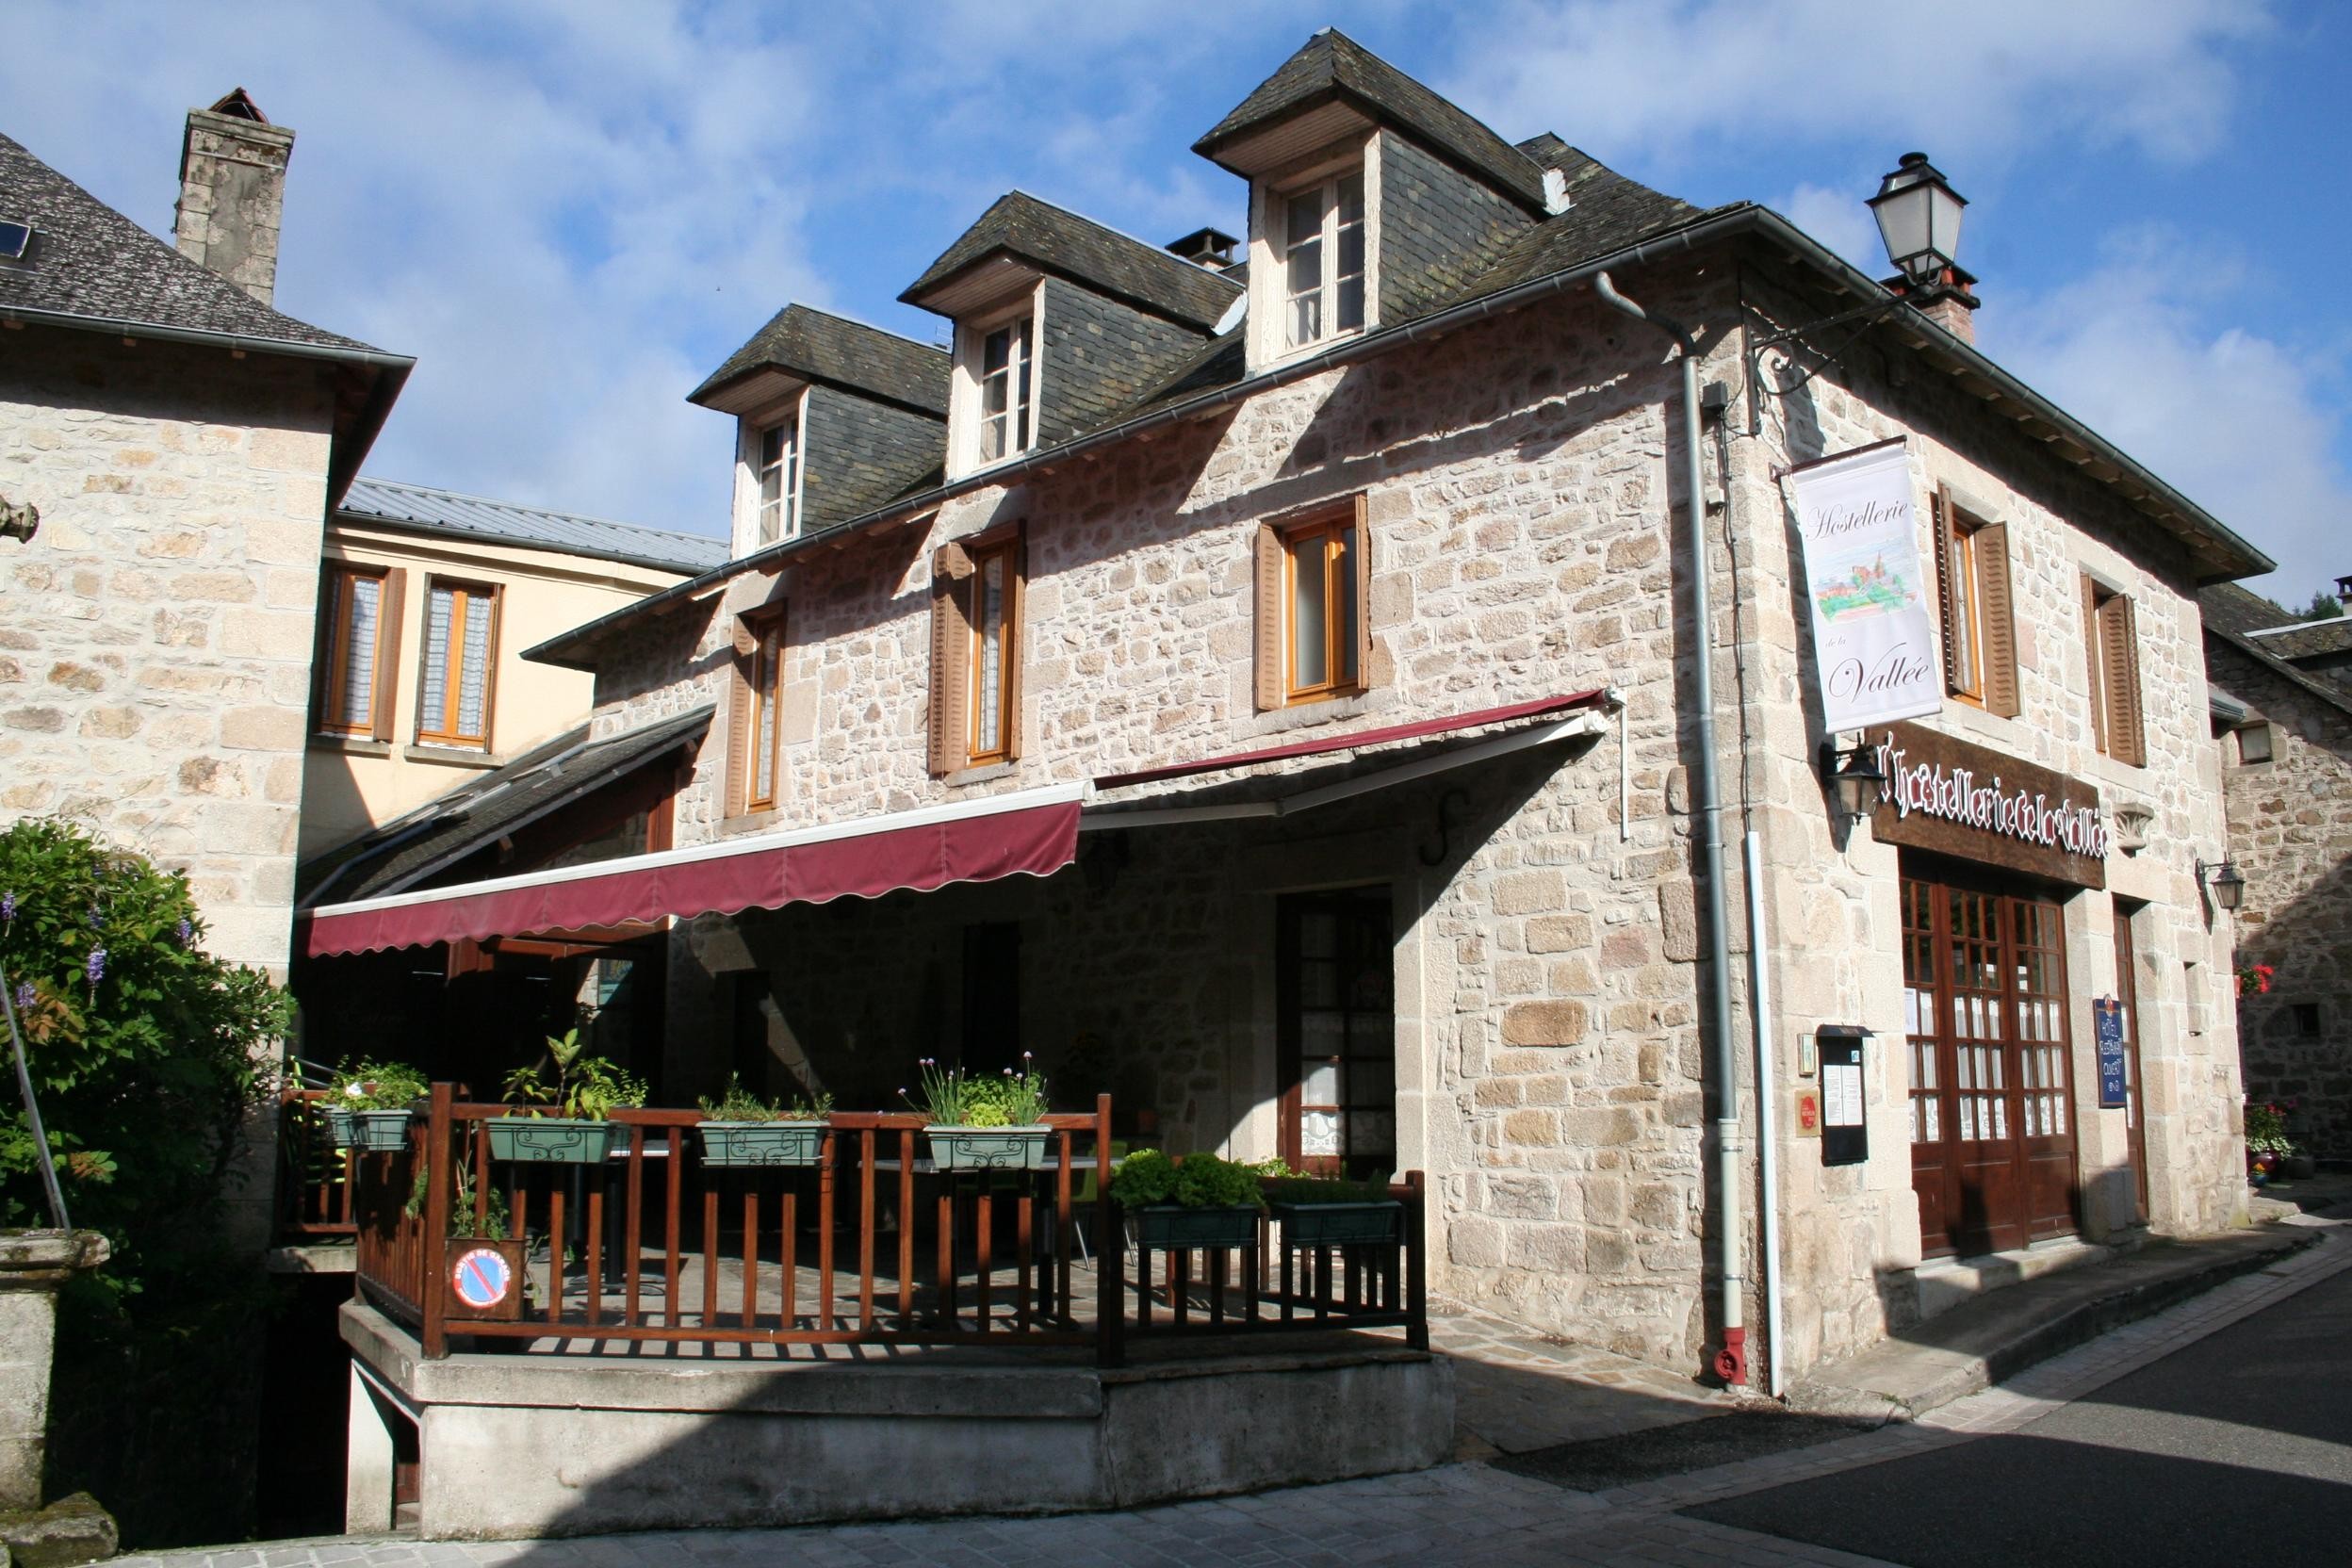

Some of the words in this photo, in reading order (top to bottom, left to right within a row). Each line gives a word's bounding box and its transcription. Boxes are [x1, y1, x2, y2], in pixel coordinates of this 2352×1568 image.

[1805, 500, 1908, 540] Hostellerie
[1825, 635, 1837, 648] de
[1828, 642, 1929, 704] Vallée
[2015, 789, 2036, 841] de
[2036, 793, 2057, 846] la
[2054, 798, 2109, 859] Vallée
[454, 1251, 476, 1280] SORTIE
[489, 1251, 511, 1282] GARAGE
